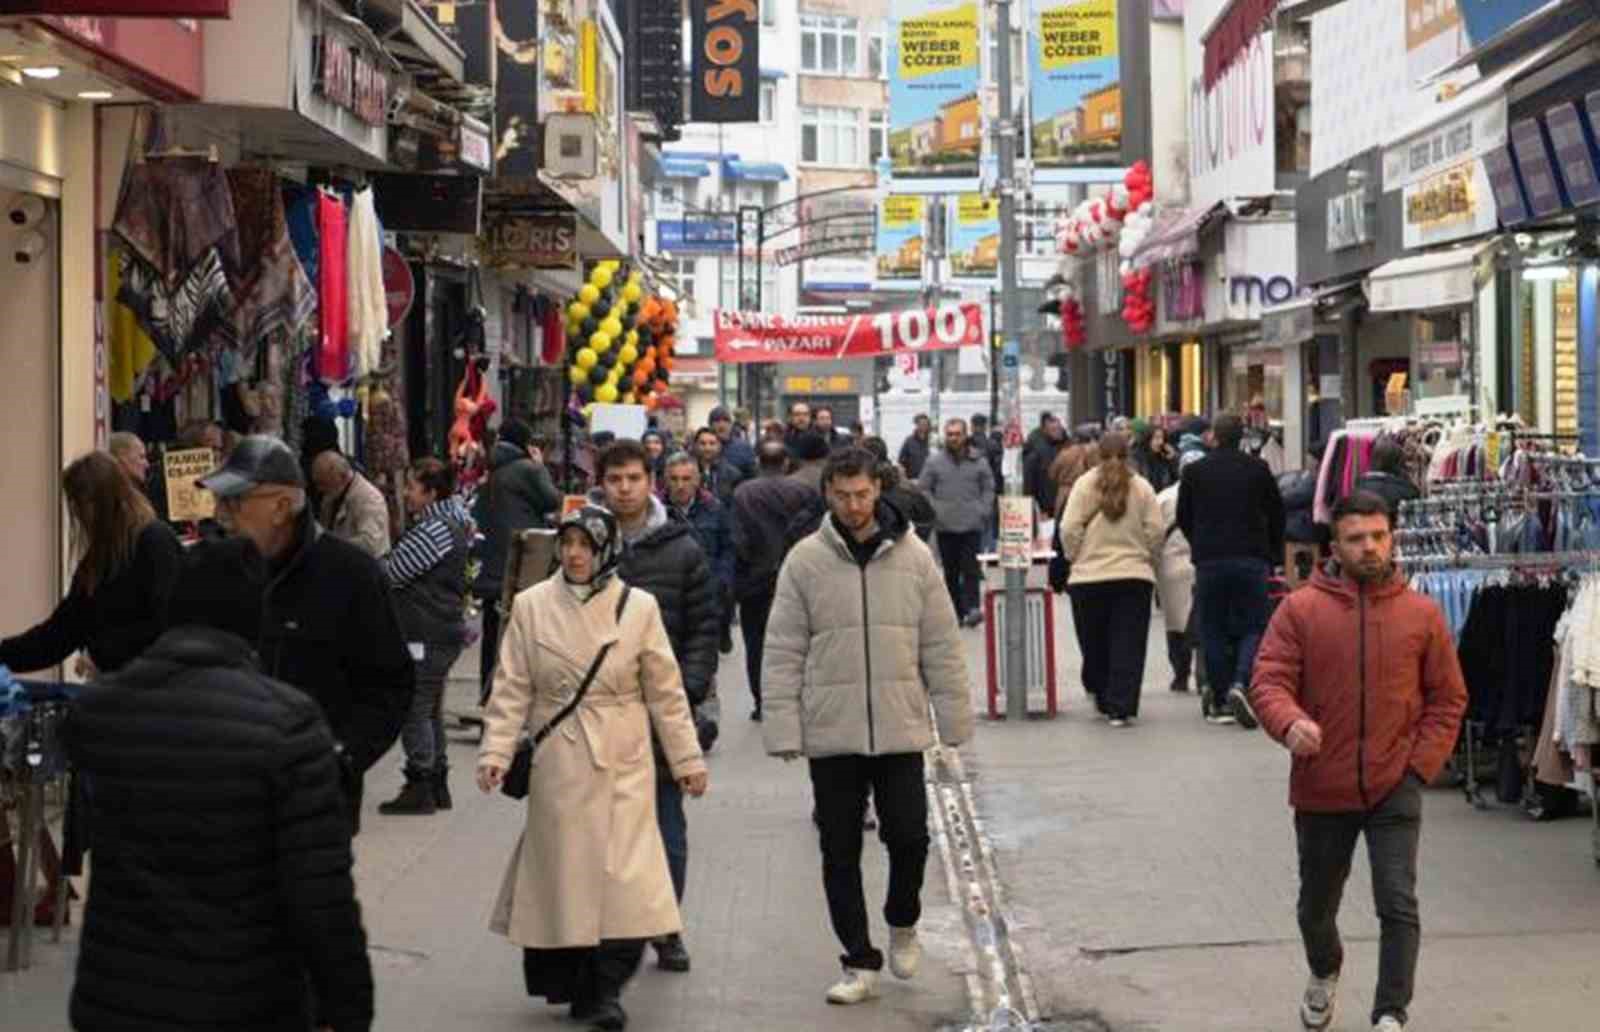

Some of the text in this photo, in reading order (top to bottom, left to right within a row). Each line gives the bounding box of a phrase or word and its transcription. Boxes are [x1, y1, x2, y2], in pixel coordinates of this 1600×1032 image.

[1043, 30, 1100, 43] WEBER
[903, 40, 960, 52] WEBER
[1044, 45, 1102, 59] ÇÖZER!
[903, 54, 962, 68] ÇÖZER!
[764, 335, 833, 352] PAZARI
